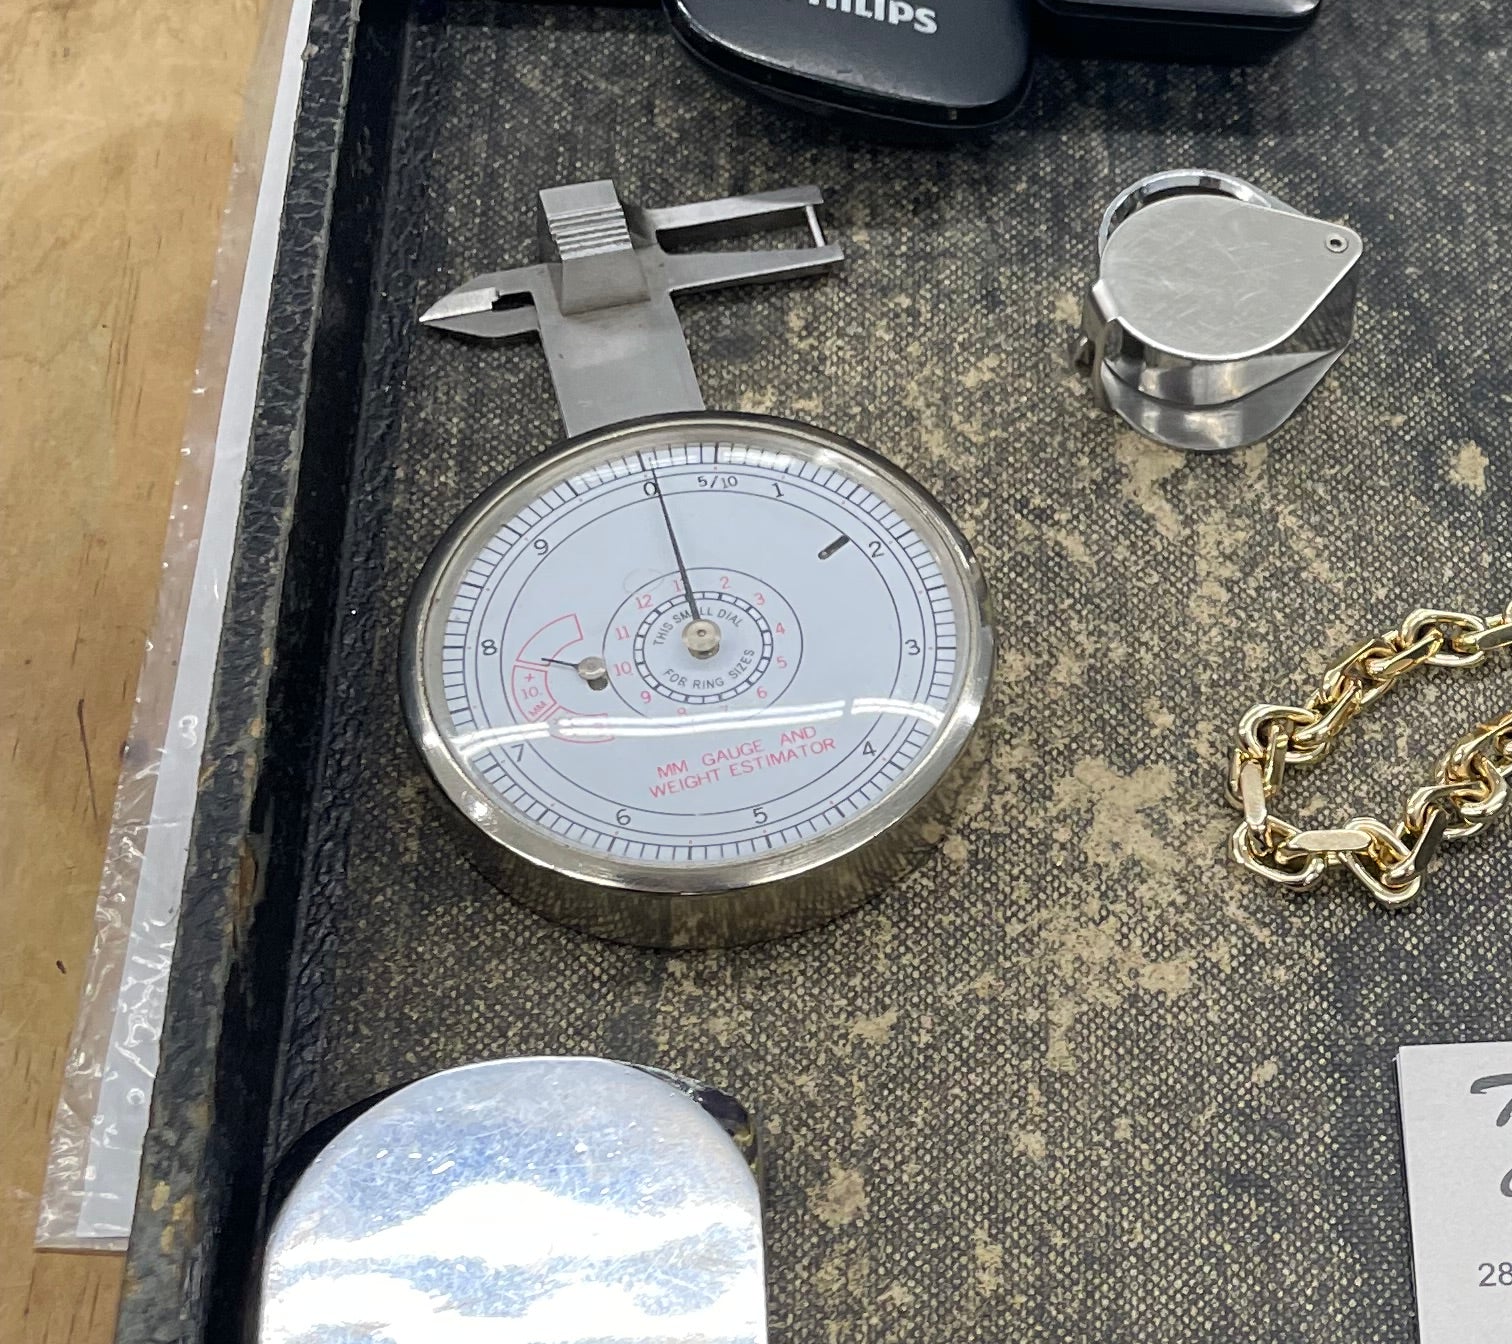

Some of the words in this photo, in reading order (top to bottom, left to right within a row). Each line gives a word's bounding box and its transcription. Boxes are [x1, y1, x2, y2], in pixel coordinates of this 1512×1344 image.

[696, 473, 739, 491] 5/10
[773, 482, 785, 499] 1
[532, 538, 551, 557] 9
[868, 539, 886, 559] 2
[719, 575, 732, 591] 2
[634, 593, 654, 610] 12
[753, 591, 766, 607] 3
[614, 625, 631, 641] 11
[651, 621, 675, 648] THIS
[672, 605, 714, 625] SMLL
[716, 608, 744, 629] DIAL
[774, 621, 786, 635] 4
[480, 638, 498, 657] 8
[904, 638, 922, 657] 3
[614, 660, 633, 677] 10
[662, 667, 689, 687] FOR
[691, 676, 726, 690] RING
[727, 648, 756, 680] SIZES
[775, 655, 788, 670] 5
[639, 689, 653, 704] 9
[756, 686, 769, 700] 6
[510, 742, 527, 763] 7
[655, 758, 690, 781] MM
[701, 738, 766, 768] GAUGE
[779, 724, 818, 746] AND
[861, 740, 878, 758] 4
[647, 769, 723, 800] WEIGHT
[729, 736, 838, 778] ESTIMATOR
[615, 807, 633, 827] 6
[751, 805, 769, 826] 5
